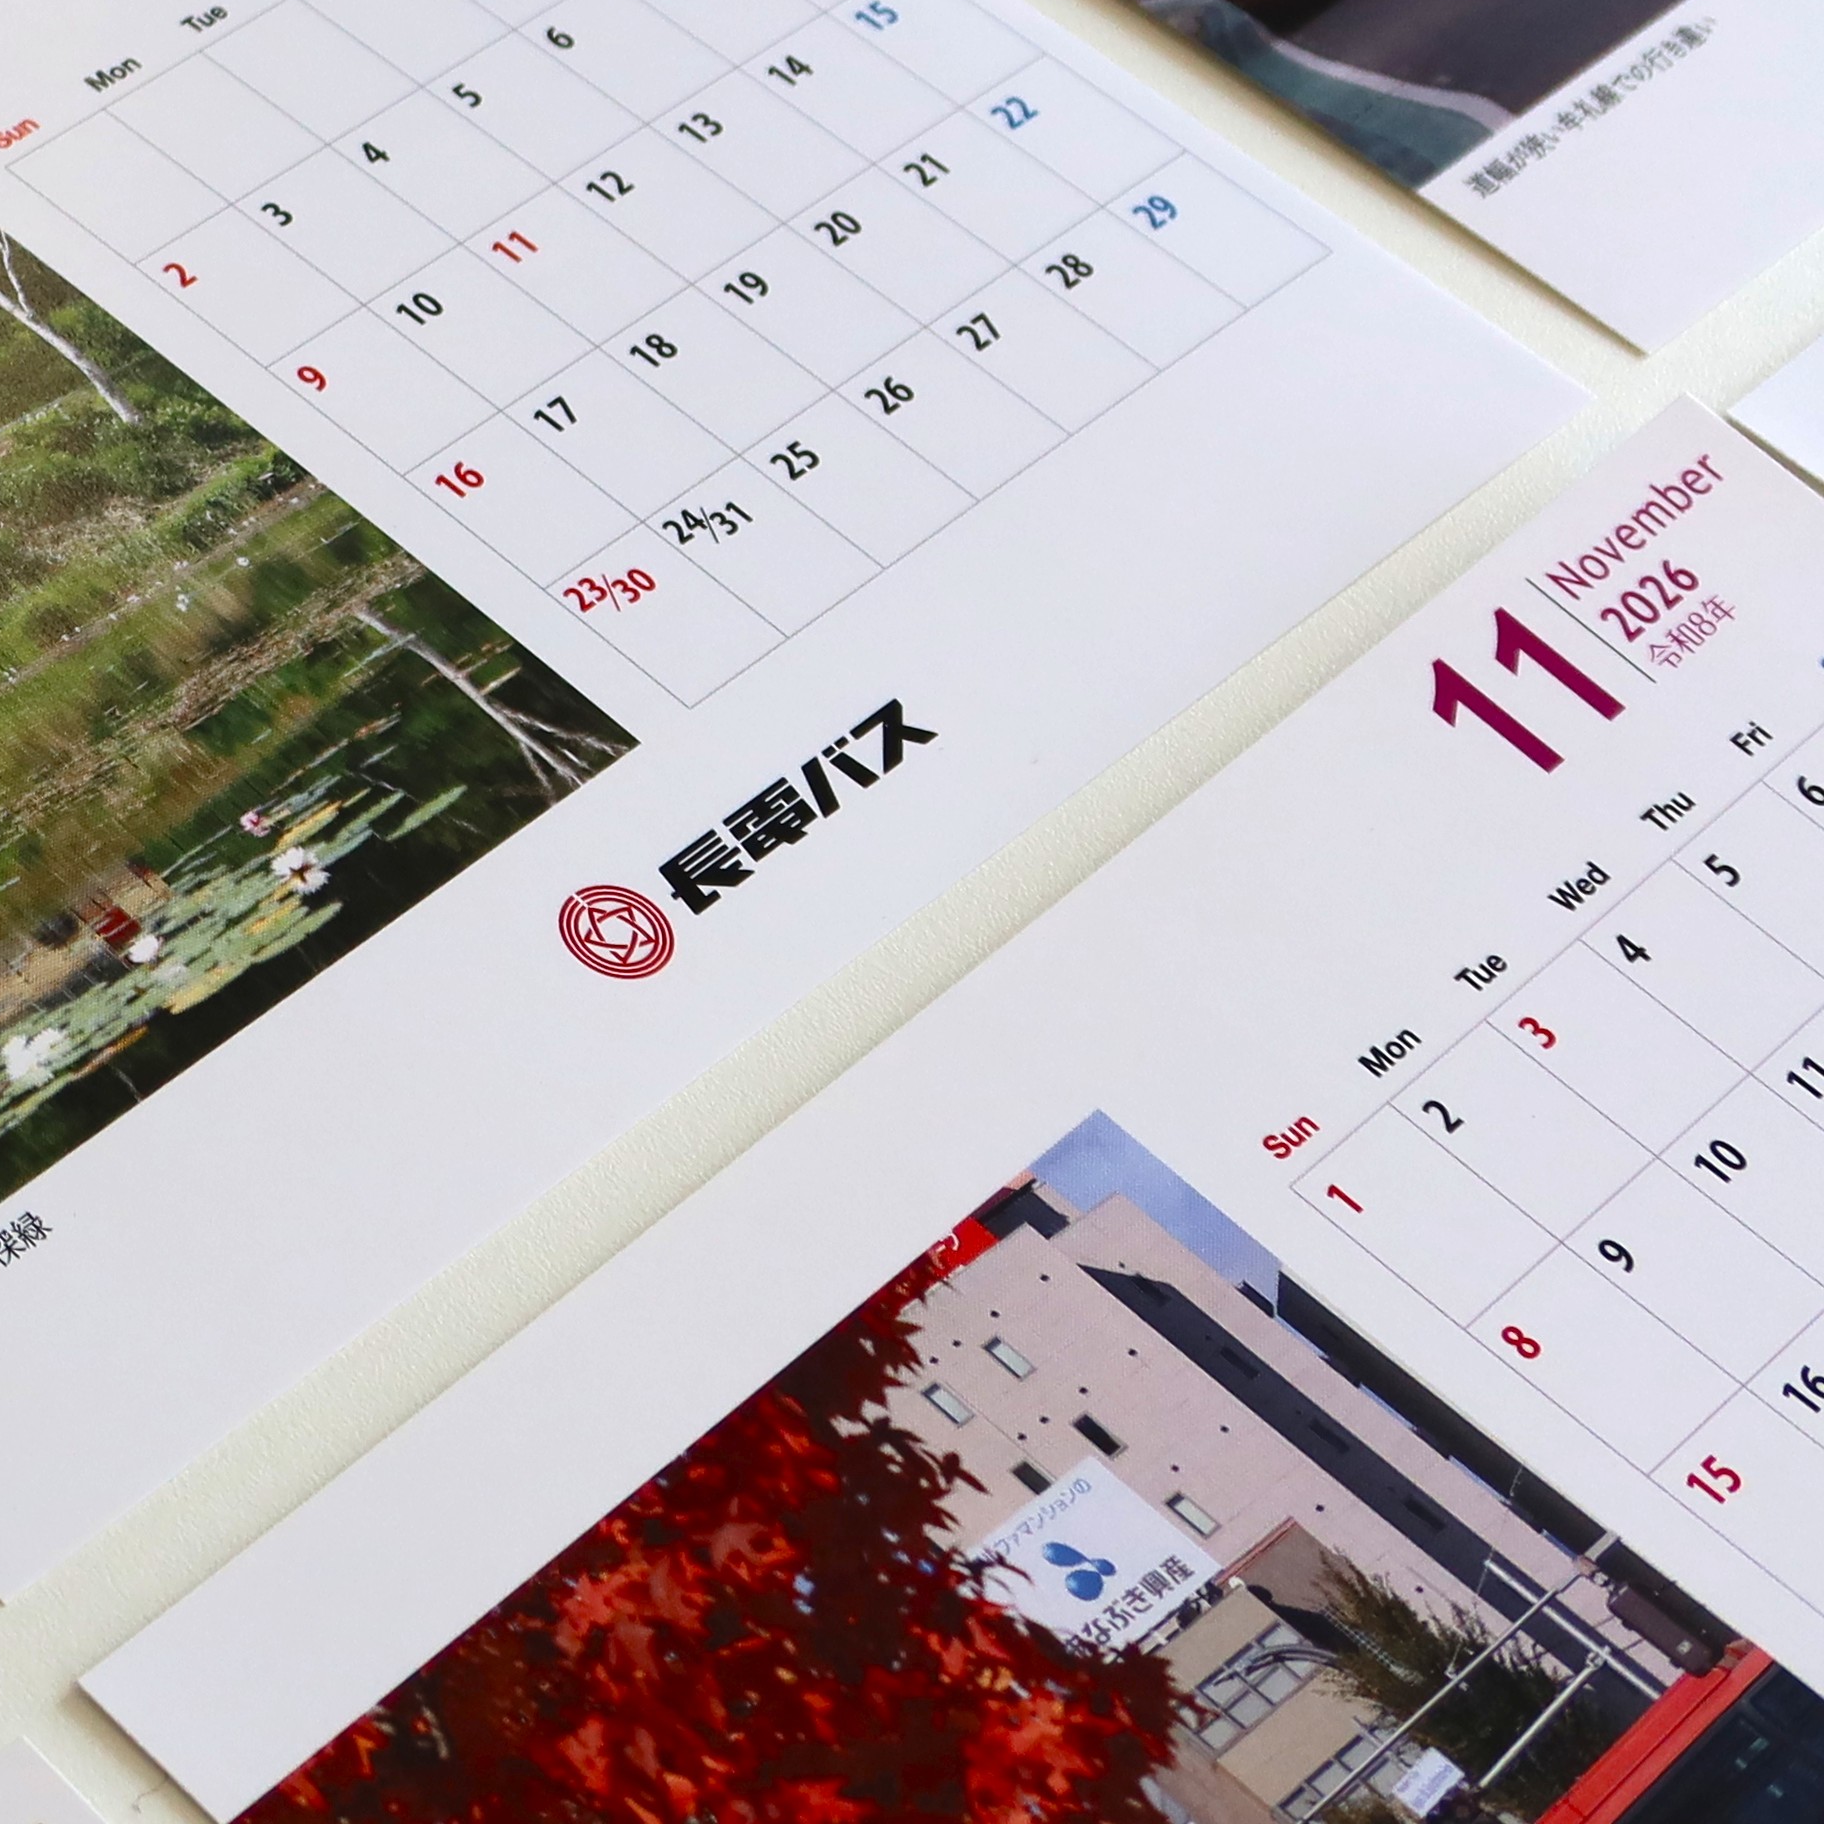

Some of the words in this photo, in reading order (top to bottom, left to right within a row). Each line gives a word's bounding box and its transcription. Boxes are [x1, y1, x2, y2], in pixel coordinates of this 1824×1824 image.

[82, 57, 143, 94] Mon
[178, 5, 229, 34] Tue
[162, 262, 198, 288] 2
[260, 202, 293, 227] 3
[361, 141, 390, 164] 4
[451, 83, 482, 109] 5
[546, 26, 575, 50] 6
[296, 365, 327, 392] 9
[396, 292, 444, 326] 10
[491, 231, 538, 263] 11
[586, 171, 635, 203] 12
[677, 112, 724, 143] 13
[767, 55, 814, 86] 14
[435, 461, 485, 498] 16
[533, 395, 577, 432] 17
[629, 333, 678, 368] 18
[723, 271, 769, 305] 19
[813, 211, 862, 247] 20
[903, 153, 950, 188] 21
[562, 568, 656, 613] 23/30
[661, 501, 753, 545] 24/31
[769, 440, 820, 481] 25
[863, 376, 915, 416] 26
[955, 312, 1000, 352] 27
[1044, 253, 1094, 290] 28
[1131, 195, 1178, 231] 29
[1545, 455, 1722, 600] November
[1601, 560, 1699, 642] 2026
[1649, 596, 1734, 668] 令和8年
[1433, 607, 1625, 773] 11
[659, 699, 938, 915] 長電バス
[1261, 1115, 1321, 1161] Sun
[1356, 1028, 1423, 1079] Mon
[1452, 953, 1509, 993] Tue
[1546, 860, 1612, 912] Wed
[1638, 791, 1698, 832] Thu
[1728, 724, 1774, 758] Fri
[1326, 1184, 1364, 1214] 1
[1421, 1099, 1465, 1134] 2
[1517, 1016, 1557, 1050] 3
[1616, 934, 1652, 963] 4
[1703, 853, 1741, 888] 5
[1797, 776, 1824, 806] 6
[1501, 1325, 1541, 1360] 8
[1597, 1239, 1634, 1273] 9
[1694, 1139, 1747, 1184] 10
[1686, 1454, 1742, 1504] 15
